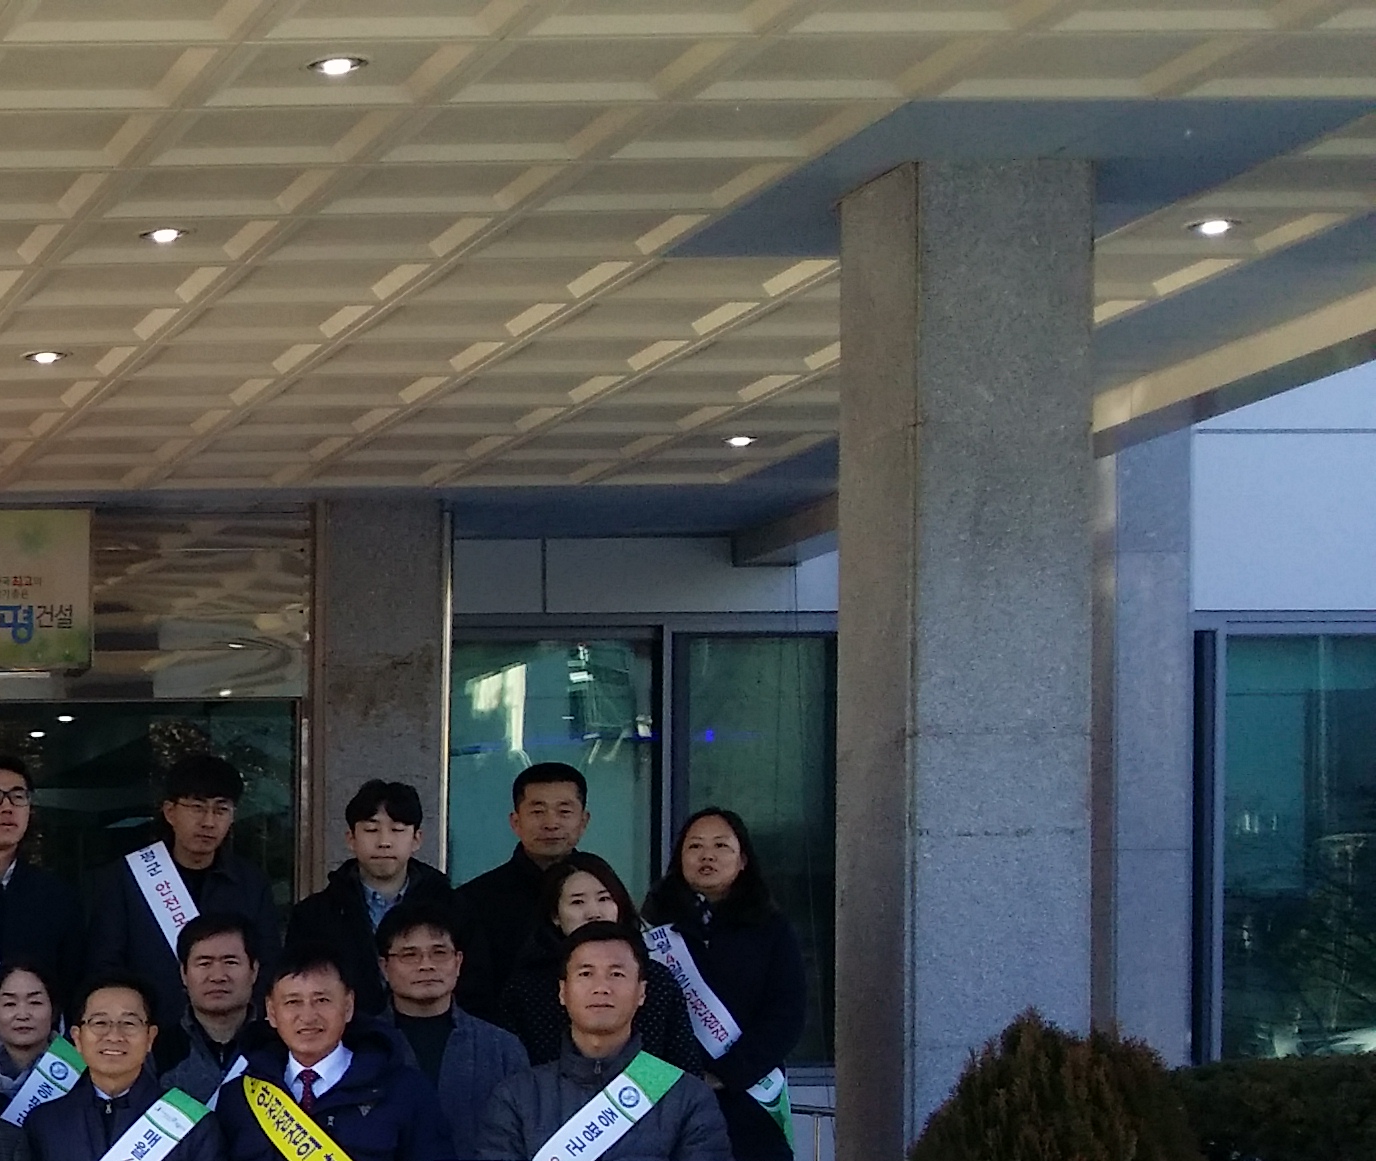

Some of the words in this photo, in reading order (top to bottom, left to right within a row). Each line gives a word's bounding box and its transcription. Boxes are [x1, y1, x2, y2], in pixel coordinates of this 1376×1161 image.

[155, 879, 188, 928] 안전모
[683, 987, 728, 1044] 안전점검
[129, 1128, 161, 1161] 매월
[251, 1086, 321, 1161] 안전점검의
[564, 1106, 619, 1157] 증평군
